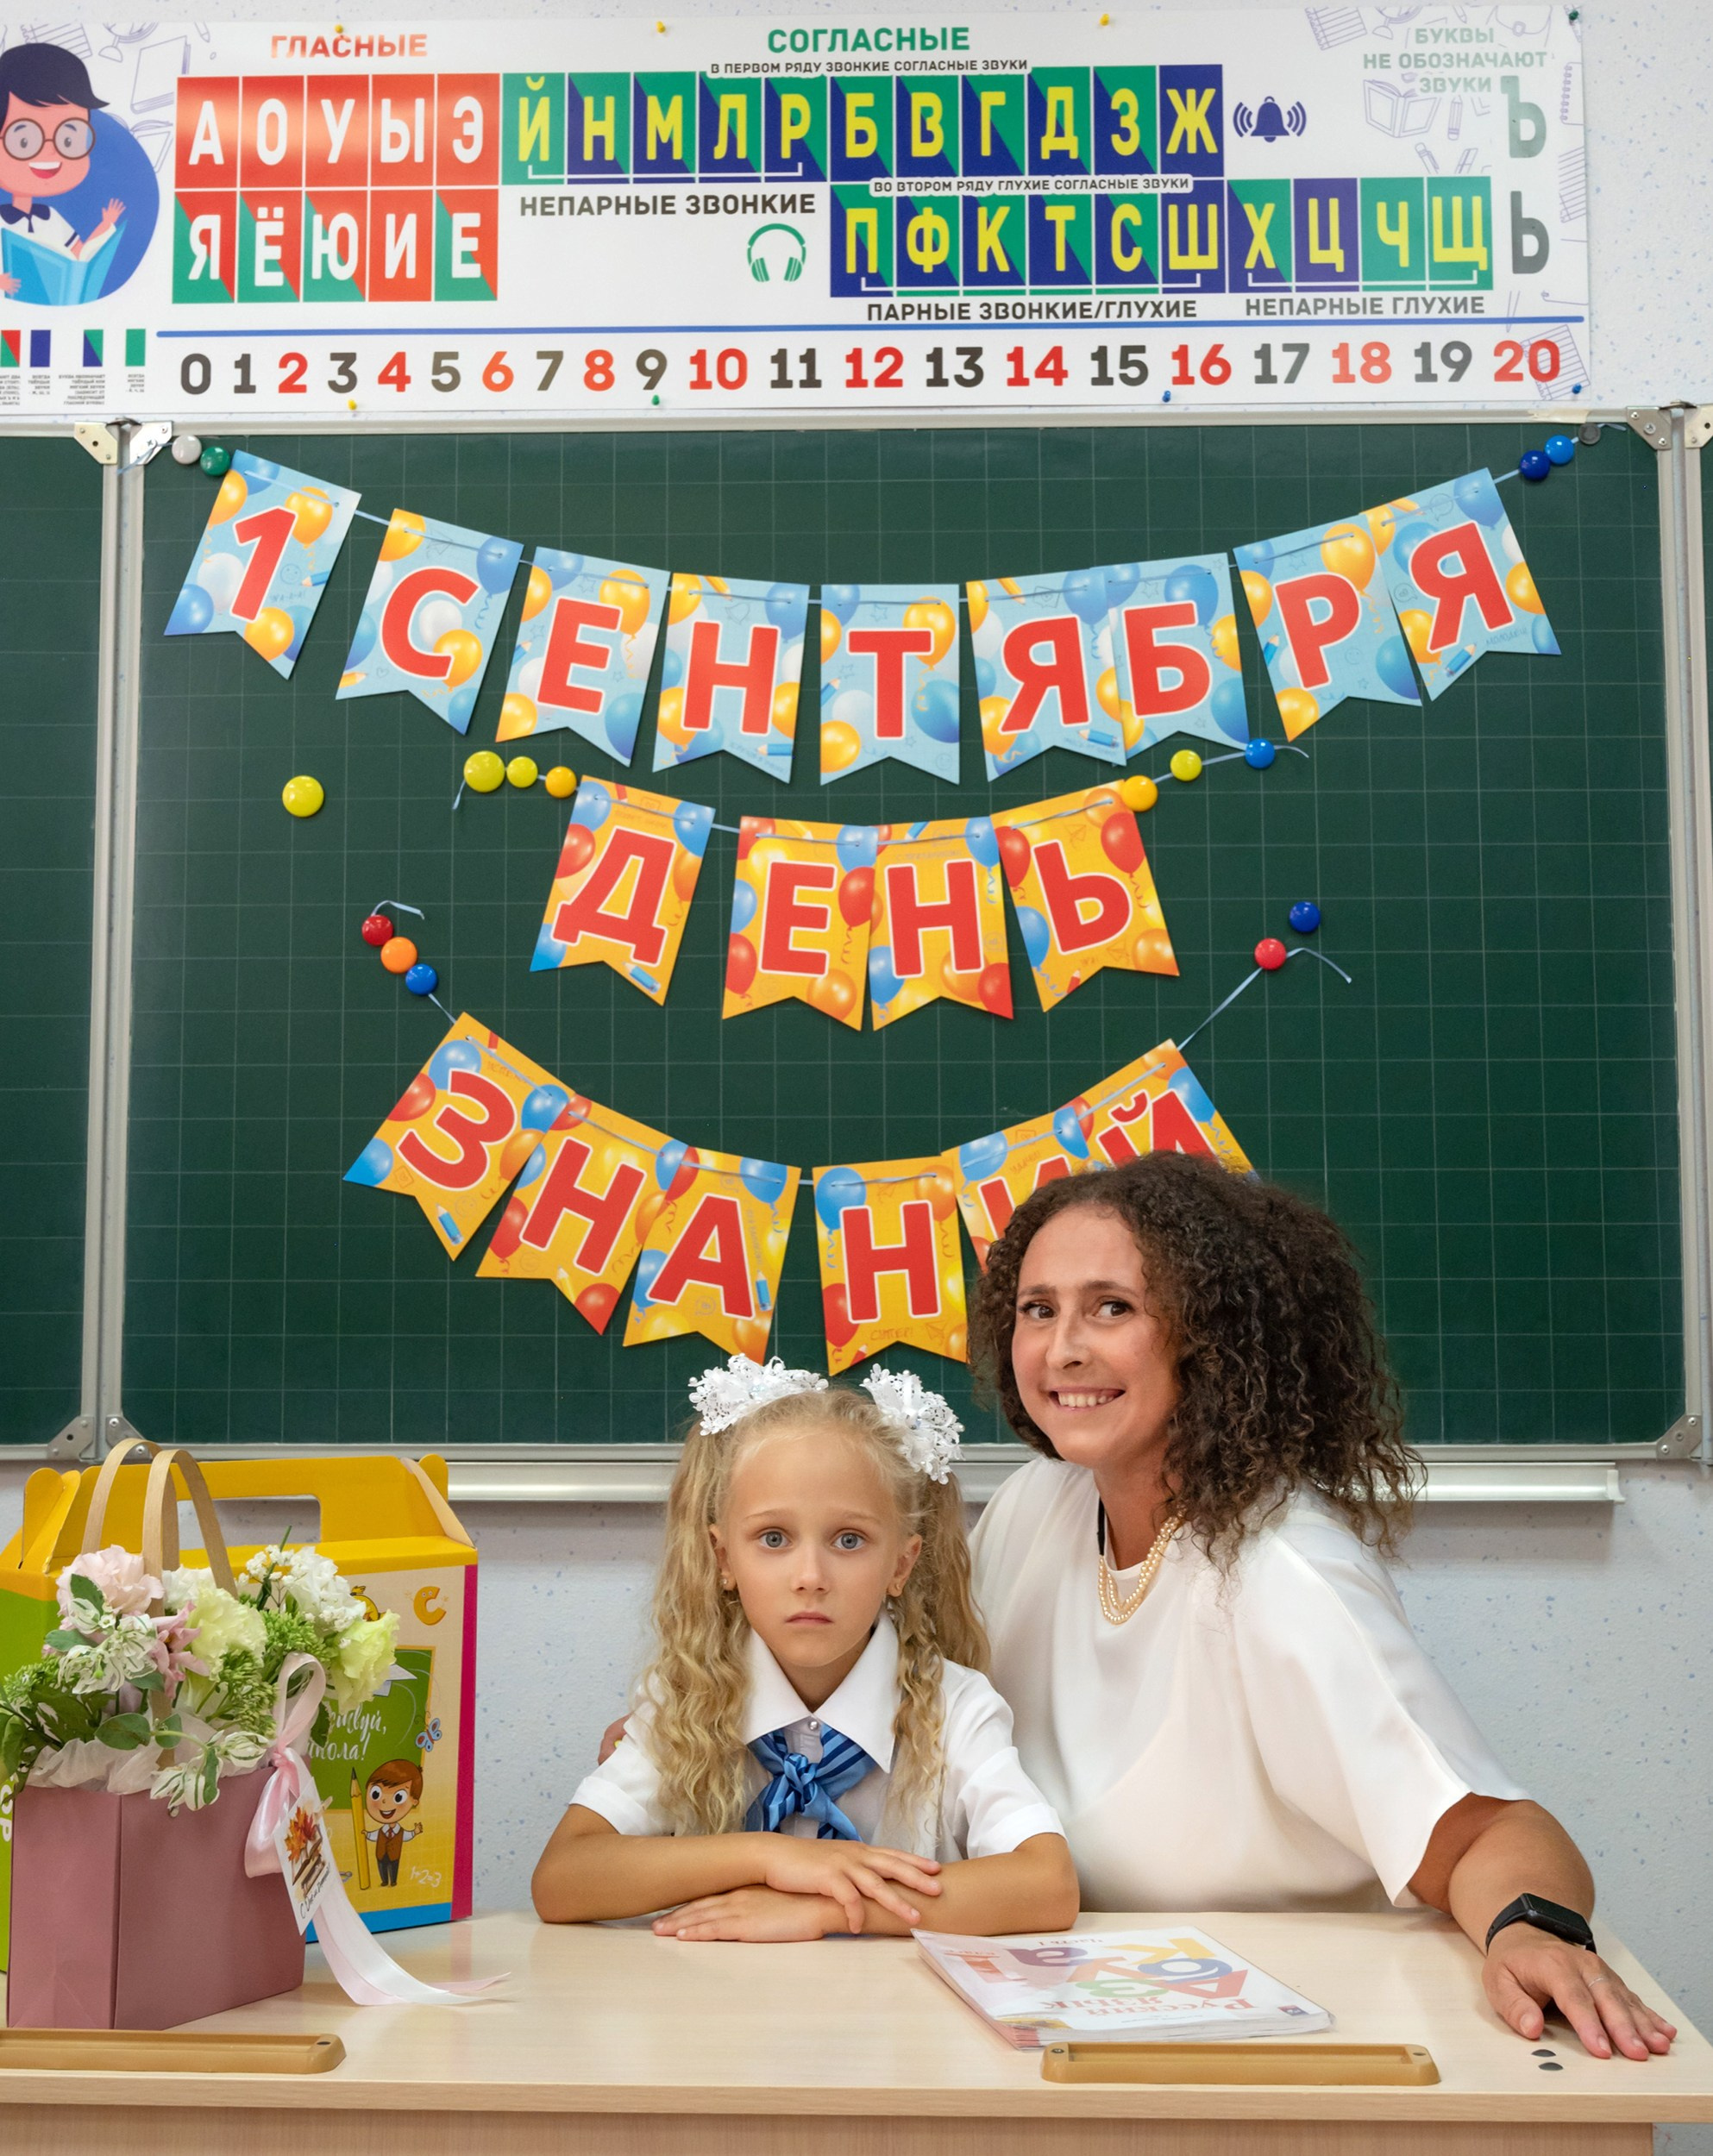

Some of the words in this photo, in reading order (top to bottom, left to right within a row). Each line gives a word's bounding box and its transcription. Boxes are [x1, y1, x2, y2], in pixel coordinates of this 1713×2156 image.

[272, 34, 427, 59] ГЛАСНЫЕ
[768, 27, 970, 53] СОГЛАСНЫЕ
[1415, 27, 1494, 45] БУКВЫ
[711, 63, 720, 74] В
[724, 62, 781, 74] ПЕРВОМ
[785, 61, 822, 75] РЯДУ
[825, 60, 890, 72] ЗВОНКИЕ
[894, 60, 977, 72] СОГЛАСНЫЕ
[982, 59, 1028, 71] ЗВУКИ
[1363, 53, 1392, 70] НЕ
[1398, 51, 1547, 70] ОБОЗНАЧАЮТ
[1419, 77, 1491, 94] ЗВУКИ
[188, 100, 224, 166] А
[256, 98, 288, 166] О
[321, 98, 355, 164] У
[380, 97, 425, 163] Ы
[452, 96, 484, 164] Э
[518, 76, 549, 161] Й
[583, 95, 615, 161] Н
[647, 95, 682, 160] М
[713, 93, 747, 160] Л
[781, 93, 811, 159] Р
[845, 92, 878, 158] Б
[911, 91, 944, 157] В
[981, 91, 1006, 156] Г
[1041, 86, 1078, 160] Д
[1111, 87, 1139, 156] З
[1166, 88, 1217, 154] Ж
[1500, 75, 1547, 159] Ъ
[874, 181, 893, 192] ВО
[896, 180, 952, 192] ВТОРОМ
[957, 179, 993, 192] РЯДУ
[997, 179, 1051, 191] ГЛУХИЕ
[1054, 178, 1138, 191] СОГЛАСНЫЕ
[1142, 178, 1189, 190] ЗВУКИ
[520, 196, 676, 216] НЕПАРНЫЕ
[685, 193, 816, 216] ЗВОНКИЕ
[846, 208, 878, 273] П
[906, 206, 951, 273] Ф
[977, 206, 1010, 273] К
[1045, 205, 1076, 272] Т
[1111, 204, 1143, 272] С
[1169, 204, 1218, 270] Ш
[1243, 203, 1276, 269] Х
[1308, 197, 1345, 273] Ц
[1377, 201, 1409, 267] Ч
[1433, 196, 1488, 271] Щ
[1509, 190, 1550, 274] Ь
[188, 214, 221, 280] Я
[254, 206, 285, 287] Ё
[311, 212, 359, 281] Ю
[385, 213, 417, 279] И
[451, 212, 481, 279] Е
[867, 301, 970, 322] ПАРНЫЕ
[978, 299, 1197, 321] ЗВОНКИЕ/ГЛУХИЕ
[1245, 297, 1384, 317] НЕПАРНЫЕ
[1391, 295, 1485, 316] ГЛУХИЕ
[180, 353, 211, 395] 0
[234, 353, 256, 394] 1
[278, 352, 308, 394] 2
[328, 352, 358, 394] 3
[377, 351, 411, 392] 4
[431, 351, 461, 392] 5
[482, 350, 514, 392] 6
[536, 350, 563, 392] 7
[583, 348, 615, 392] 8
[636, 348, 668, 391] 9
[689, 348, 748, 391] 10
[770, 348, 822, 389] 11
[845, 346, 904, 389] 12
[926, 346, 984, 388] 13
[1007, 345, 1069, 387] 14
[1090, 344, 1149, 387] 15
[1171, 343, 1232, 385] 16
[1254, 342, 1310, 385] 17
[1333, 342, 1392, 384] 18
[1414, 341, 1472, 383] 19
[1493, 340, 1560, 383] 20
[231, 506, 298, 622] 1
[380, 521, 1515, 736] СЕНТЯБРЯ
[550, 825, 1133, 977] ДЕНЬ
[1087, 1997, 1258, 2017] Русский
